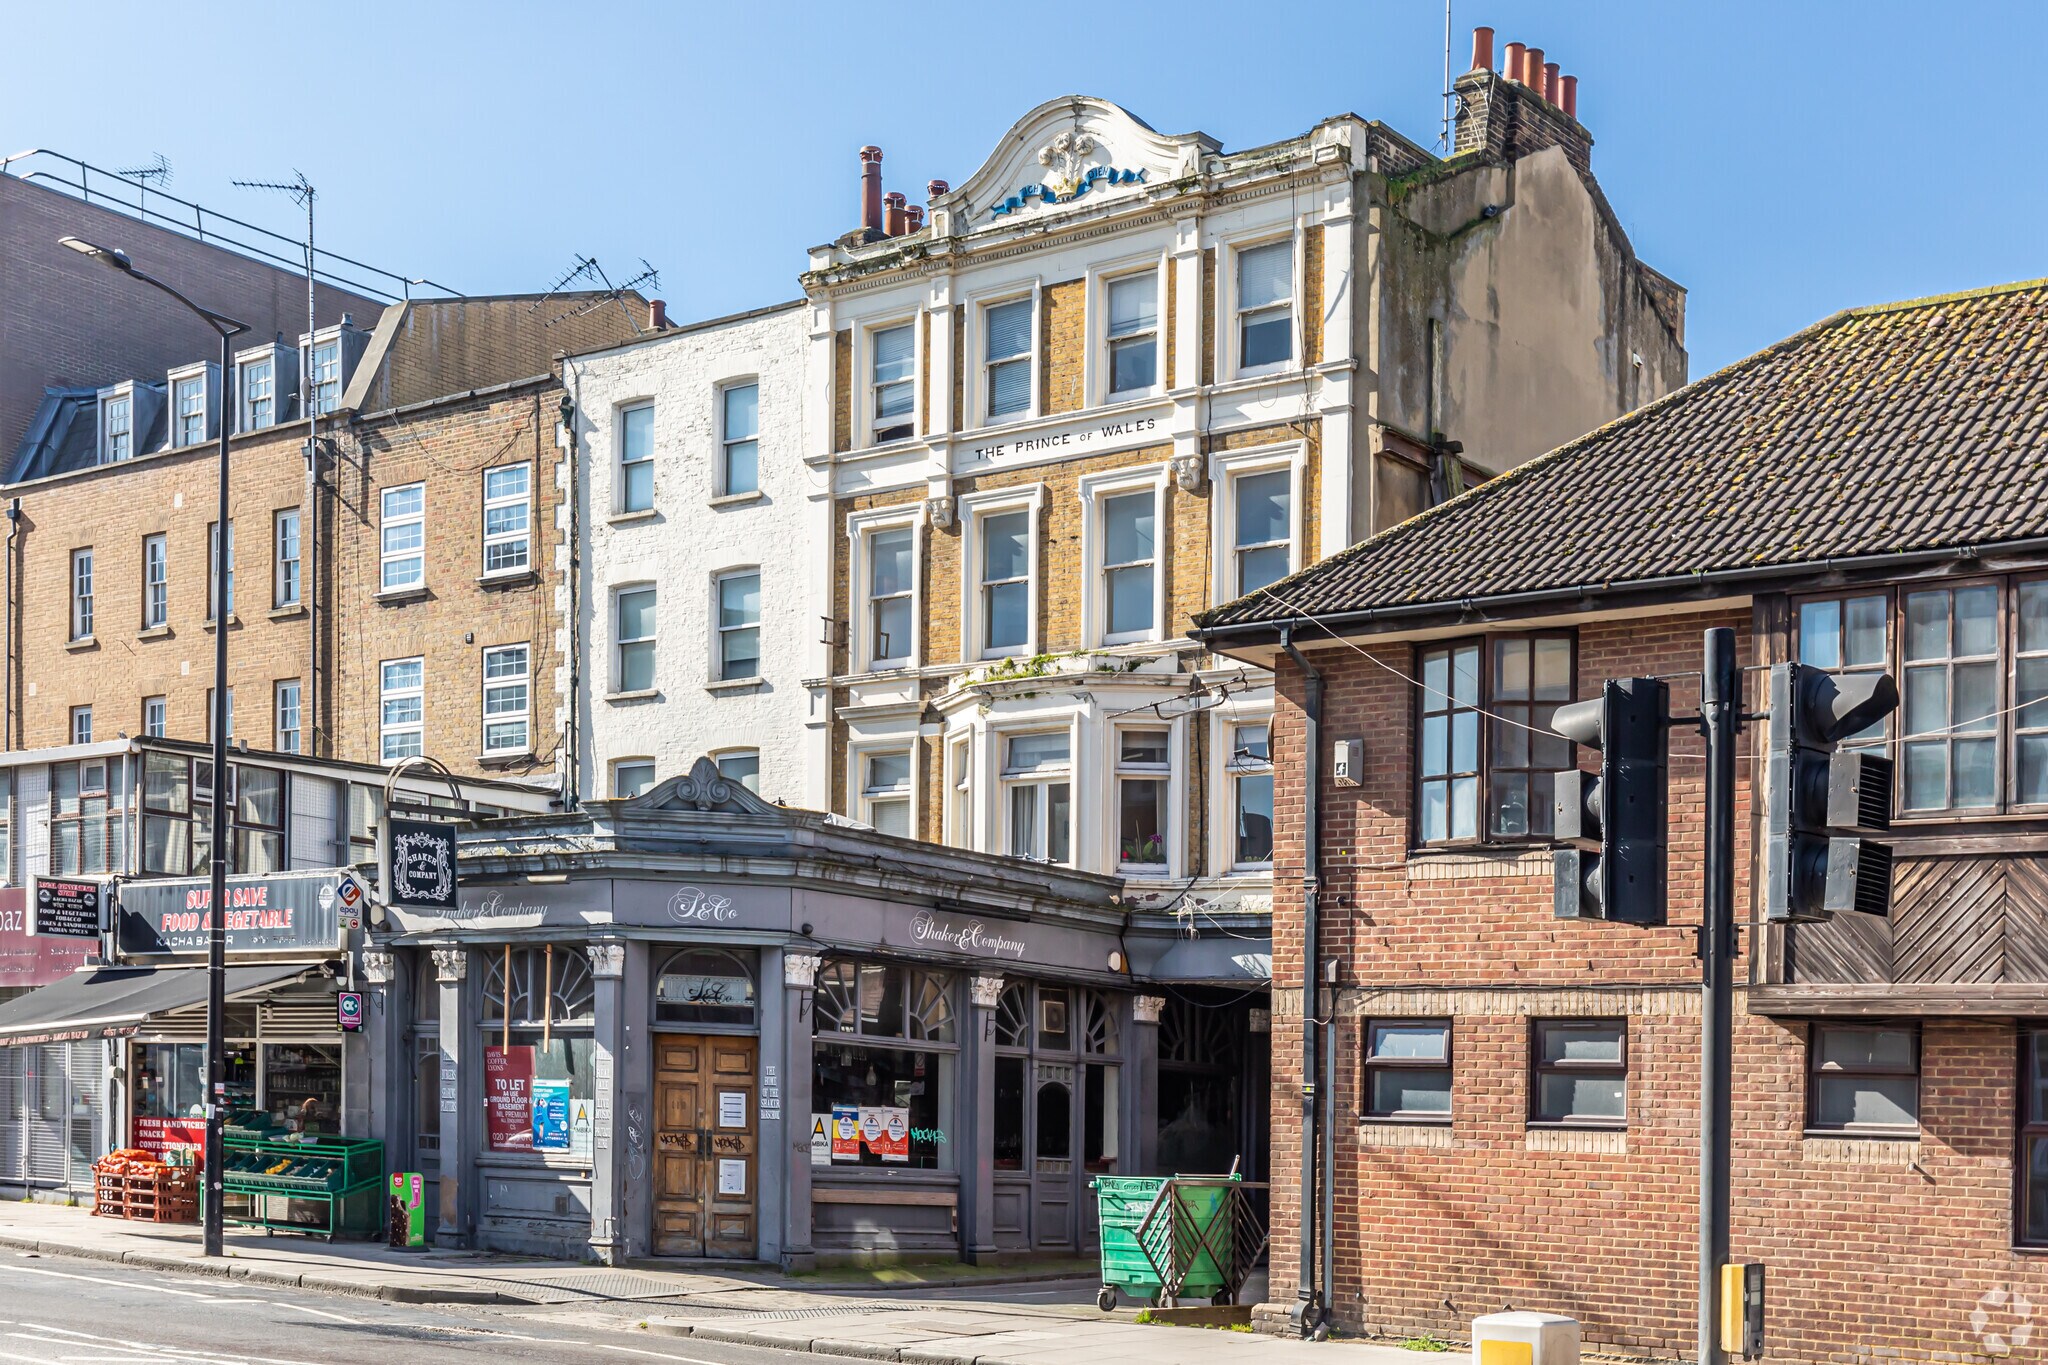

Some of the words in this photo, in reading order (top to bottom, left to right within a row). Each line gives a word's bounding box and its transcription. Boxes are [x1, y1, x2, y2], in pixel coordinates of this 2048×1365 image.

[975, 445, 1004, 460] THE
[1015, 433, 1071, 453] PRINCE
[1101, 418, 1155, 438] WALES
[407, 852, 437, 866] SHAKER
[408, 870, 438, 879] COMPANY
[186, 888, 230, 910] SUPR
[233, 886, 268, 907] SAVE
[340, 906, 359, 916] epay
[161, 912, 200, 932] FOOD
[224, 908, 293, 931] EGETABLE
[156, 936, 194, 947] KACHA
[196, 936, 234, 946] BAR
[495, 1079, 508, 1090] TO
[509, 1079, 525, 1091] LET
[139, 1119, 161, 1127] FRESH
[139, 1130, 165, 1138] SNACKS
